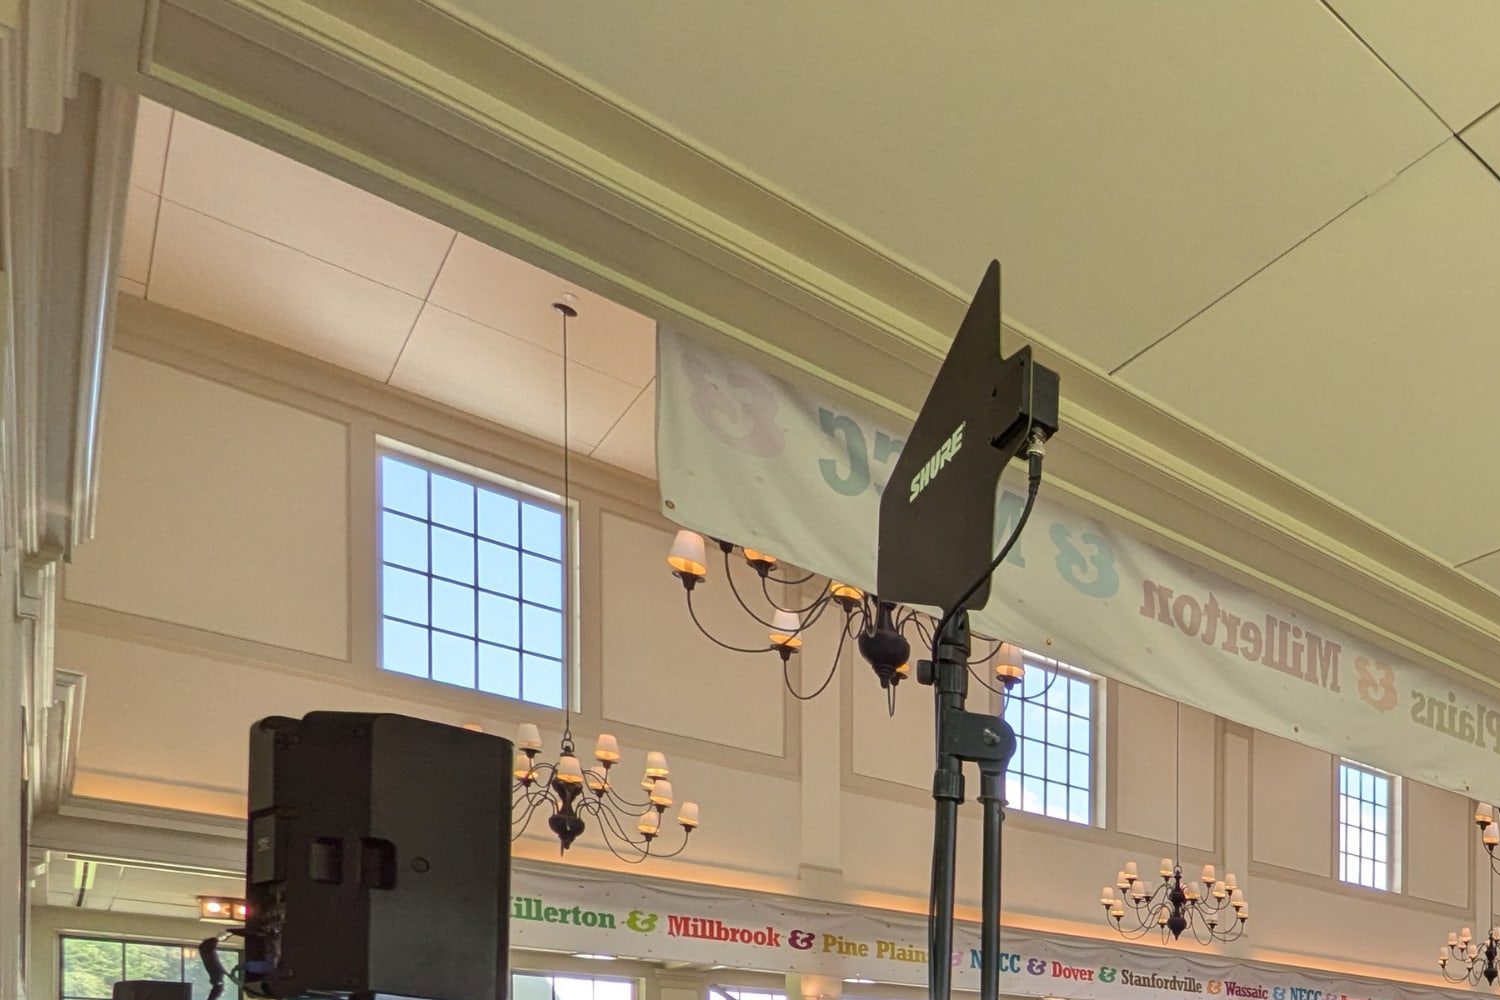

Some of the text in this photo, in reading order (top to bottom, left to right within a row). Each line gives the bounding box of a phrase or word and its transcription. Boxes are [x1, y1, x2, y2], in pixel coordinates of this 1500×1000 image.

[909, 422, 966, 503] SHURE
[510, 896, 616, 929] illerton
[626, 909, 658, 932] &
[667, 915, 780, 948] Millbrook
[788, 929, 815, 951] &
[822, 933, 869, 958] Pine
[876, 941, 929, 965] Plain
[970, 949, 1021, 973] NCC
[1026, 958, 1047, 976] &
[1052, 960, 1095, 982] Dover
[1098, 967, 1117, 984] &
[1121, 969, 1203, 996] Stanfordville
[1207, 979, 1222, 995] &
